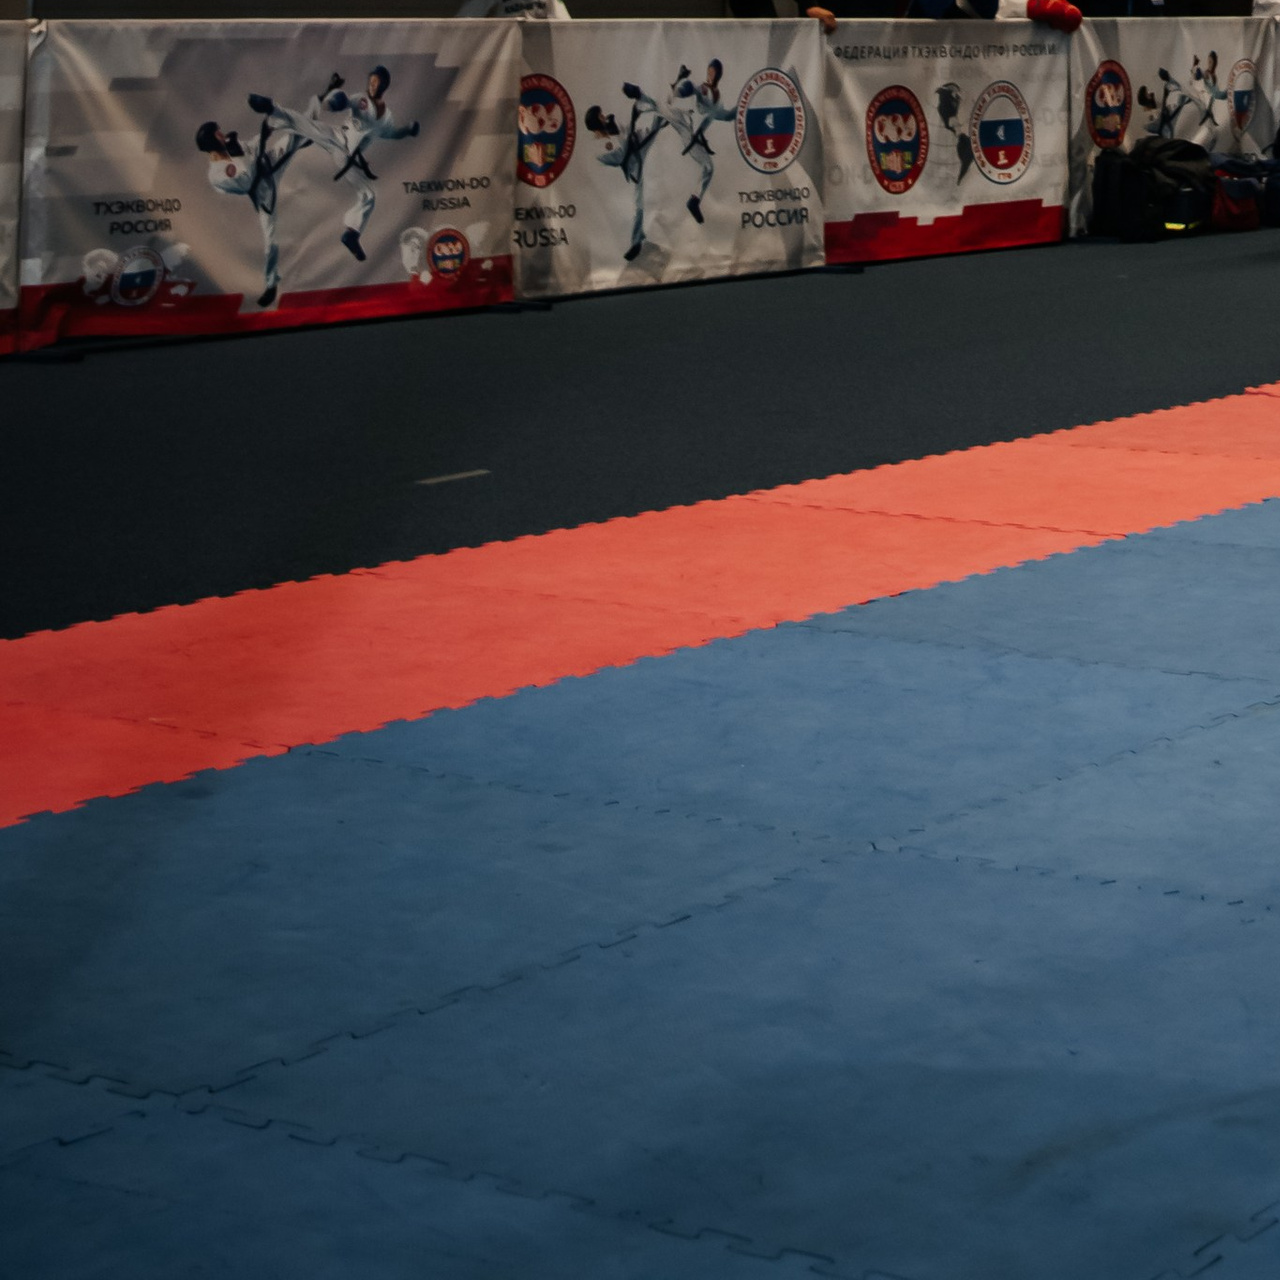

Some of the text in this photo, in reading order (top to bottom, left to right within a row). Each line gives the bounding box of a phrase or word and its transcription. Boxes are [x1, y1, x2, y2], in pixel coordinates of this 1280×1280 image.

[834, 45, 908, 60] ФЕДЕРАЦИЯ
[402, 176, 491, 194] TAEKWON-DO
[93, 198, 182, 216] ТХЭКВОНДО
[422, 196, 471, 211] RUSSIA
[109, 218, 172, 235] РОССИЯ
[741, 207, 809, 229] РОССИЯ
